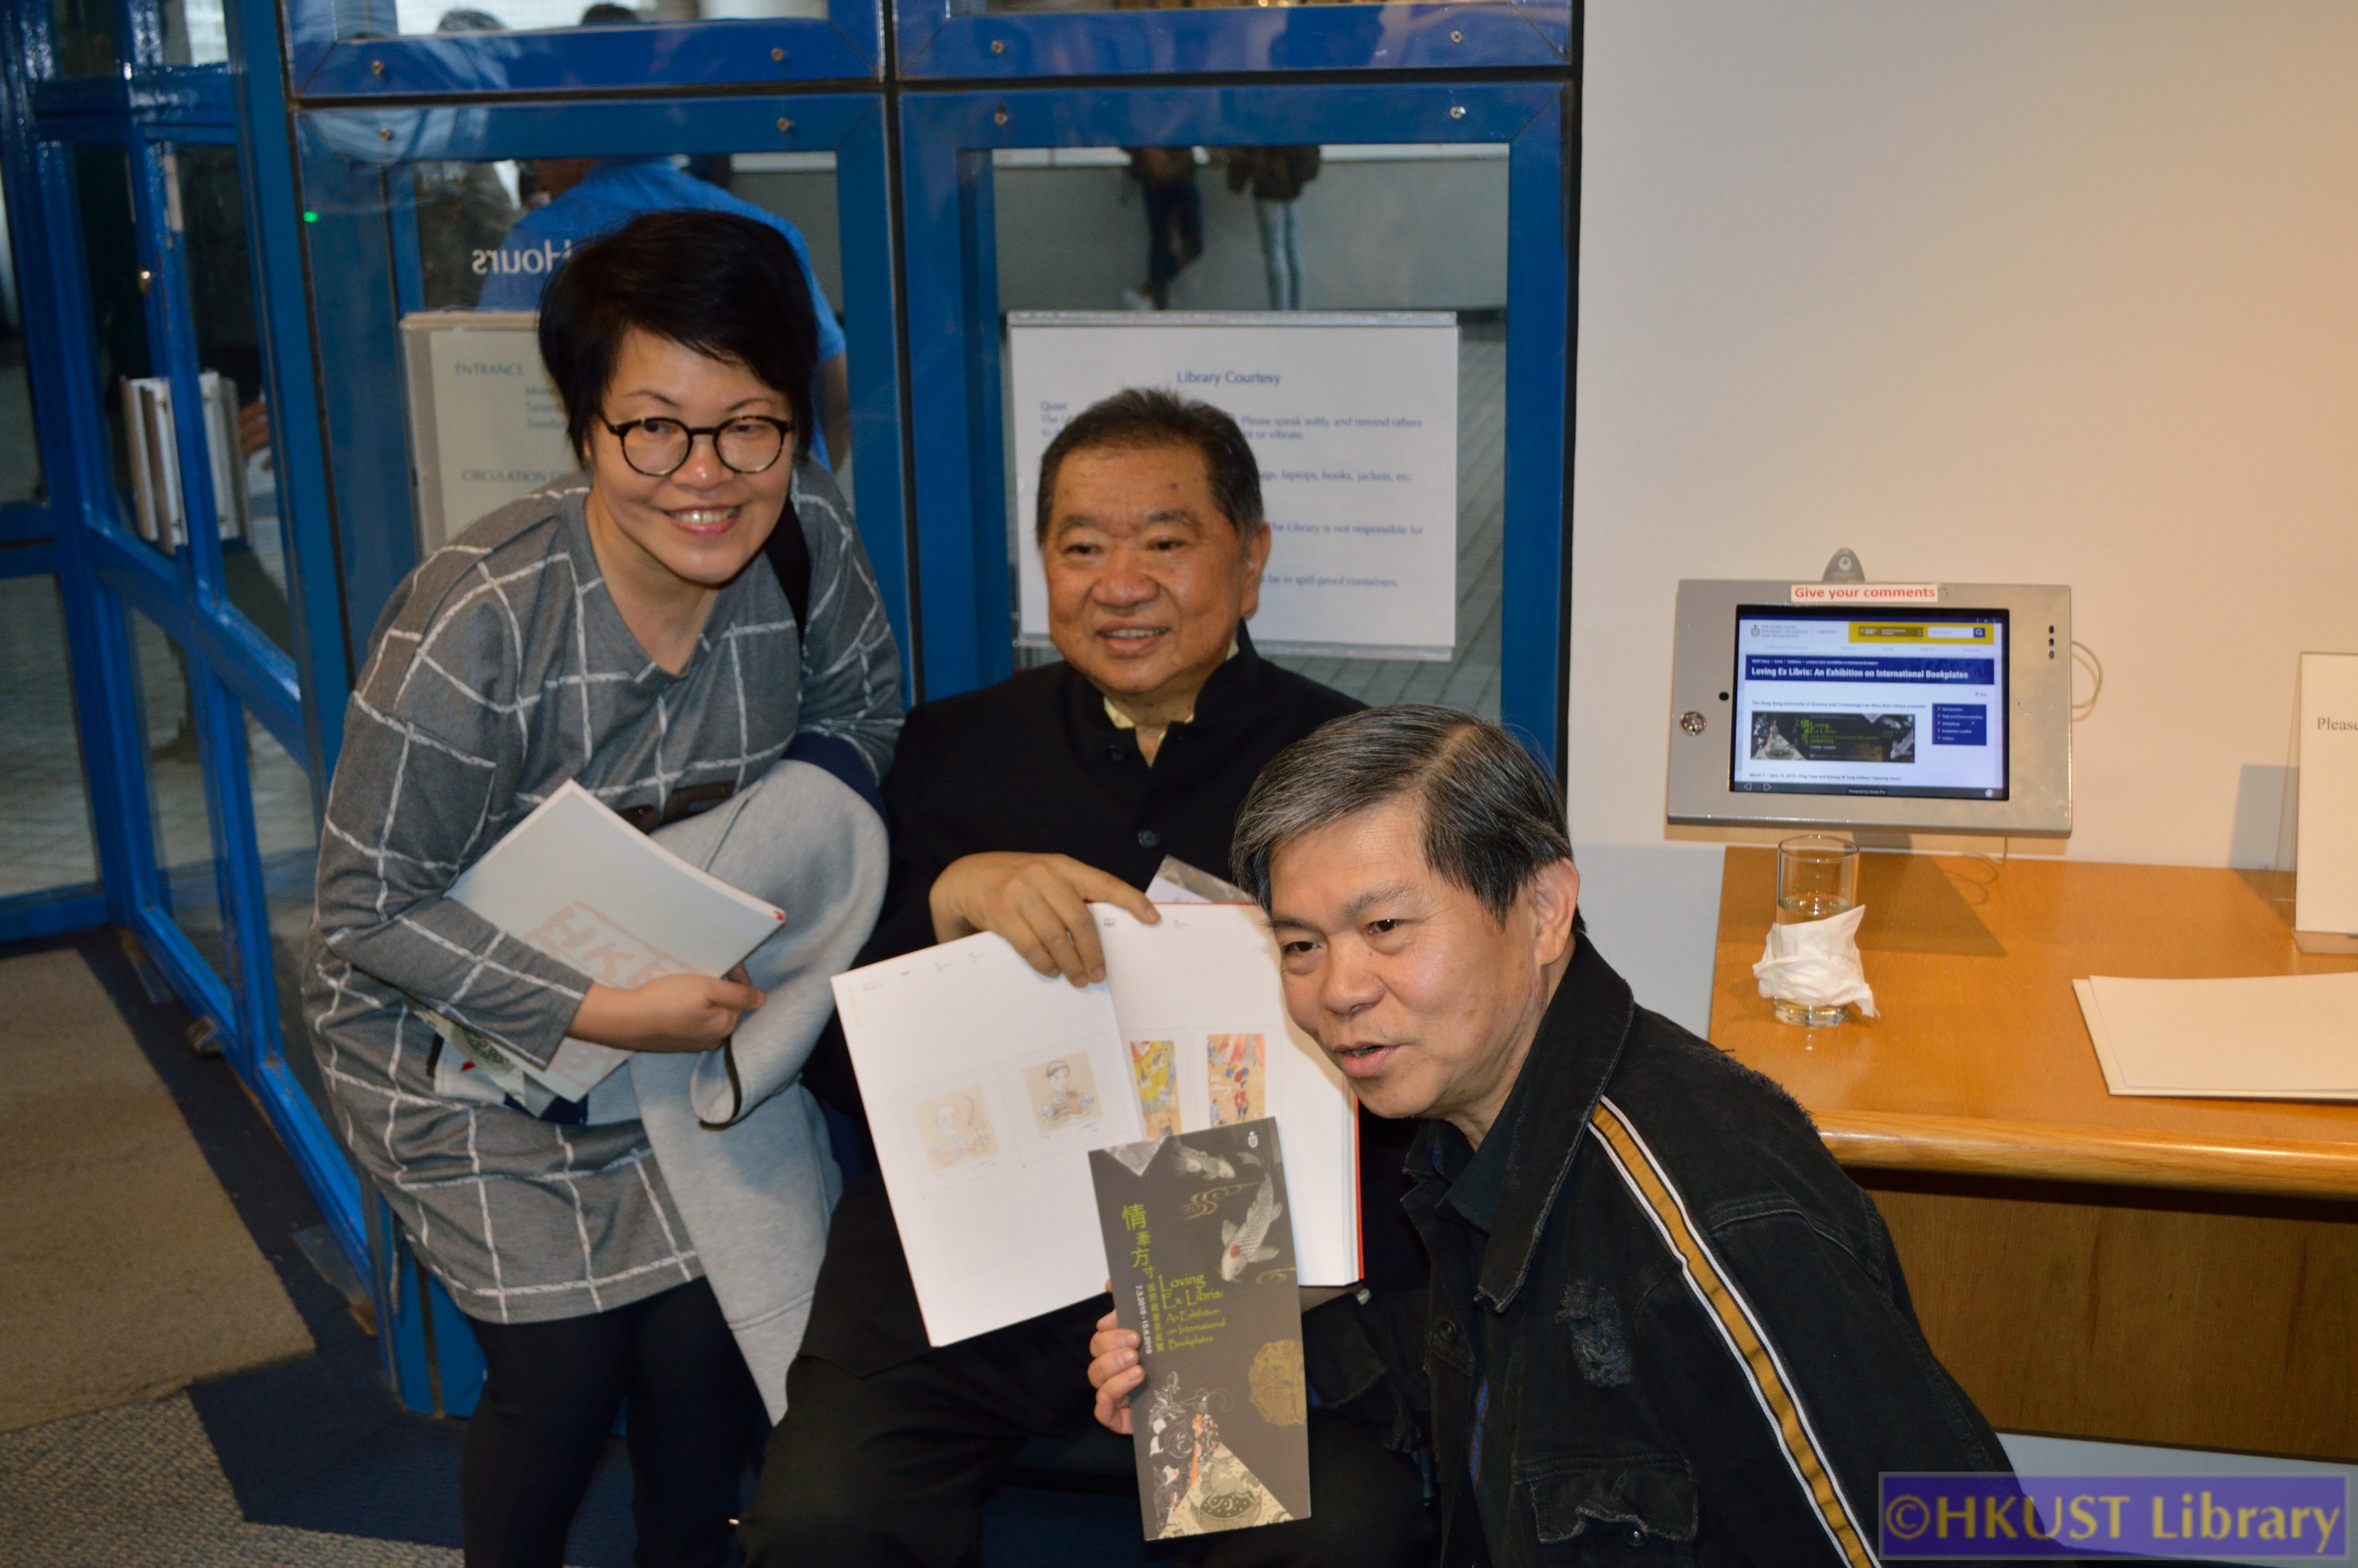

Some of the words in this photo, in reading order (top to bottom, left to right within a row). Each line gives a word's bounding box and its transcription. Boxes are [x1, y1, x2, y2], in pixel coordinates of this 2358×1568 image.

[1176, 371, 1220, 386] Library
[1225, 371, 1281, 386] Courtesy
[1039, 400, 1068, 411] Quiet
[1241, 415, 1270, 425] Please
[1274, 416, 1301, 428] speak
[1334, 416, 1352, 426] and
[1392, 417, 1422, 426] others
[1795, 587, 1824, 598] Give
[1829, 589, 1859, 599] your
[1863, 588, 1936, 598] comments
[1751, 667, 1776, 677] Loving
[1778, 667, 1787, 676] Ex
[1789, 667, 1812, 676] Libris:
[1814, 668, 1824, 677] An
[1826, 668, 1863, 677] Exhibition
[1876, 669, 1924, 679] International
[1926, 669, 1968, 680] Bookplates
[1158, 1274, 1206, 1292] Loving
[1161, 1288, 1182, 1310] Ex
[1185, 1288, 1224, 1306] Libris:
